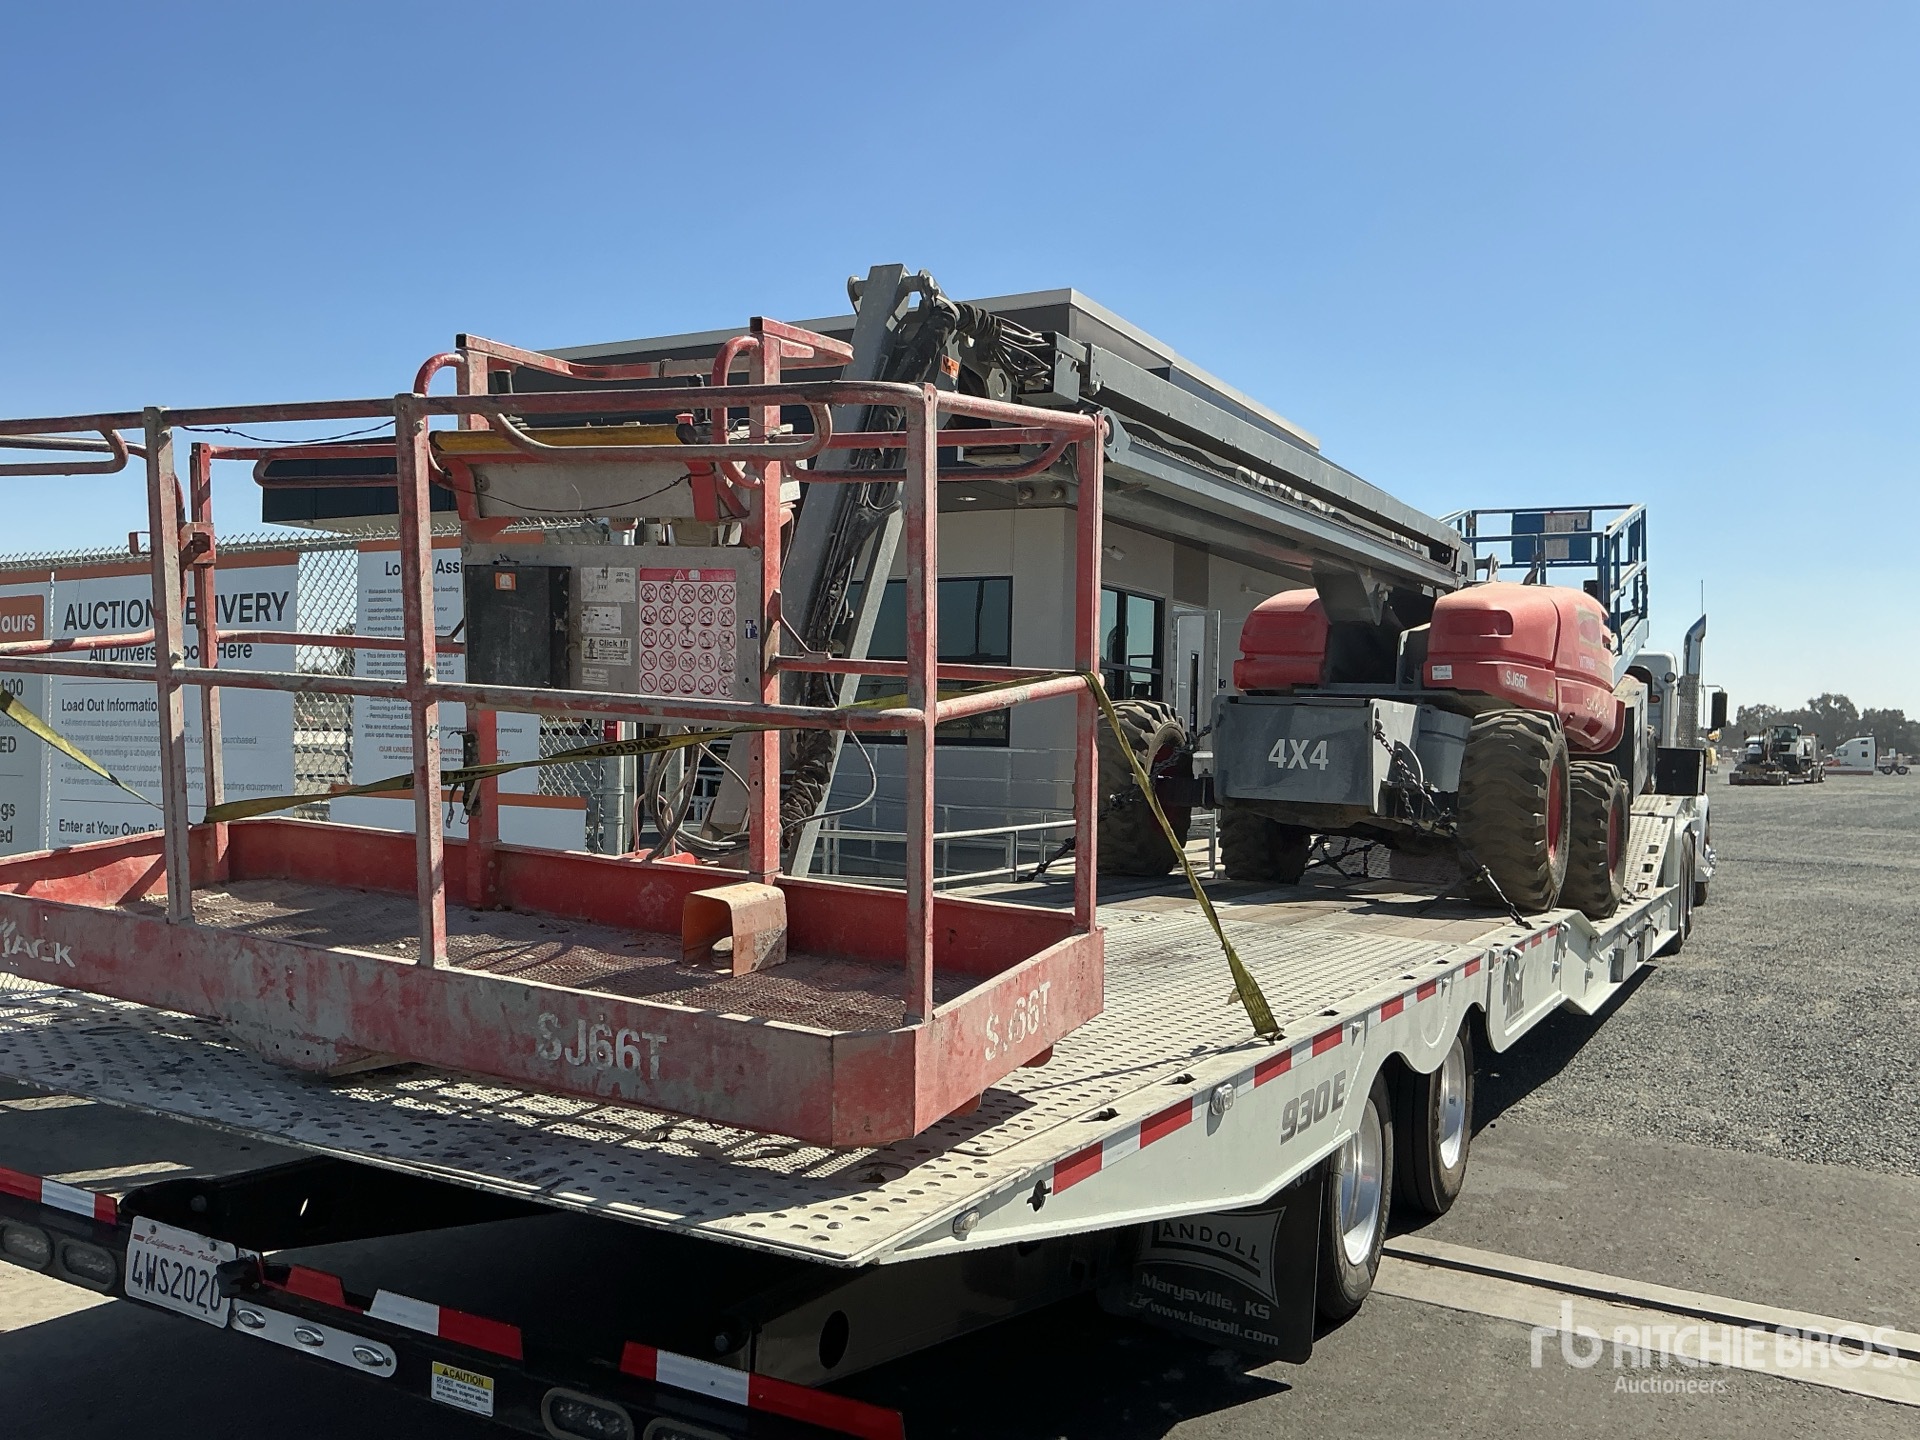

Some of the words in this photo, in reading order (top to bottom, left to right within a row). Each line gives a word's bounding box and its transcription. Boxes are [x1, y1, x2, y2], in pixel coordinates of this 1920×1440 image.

[0, 612, 36, 634] ours
[598, 639, 618, 648] Click
[1505, 670, 1528, 689] SJ66T
[61, 699, 85, 712] Load
[87, 698, 106, 712] Out
[107, 697, 160, 712] Informatio
[1268, 738, 1329, 771] 4X4
[59, 819, 84, 833] Enter
[85, 821, 95, 834] at
[96, 821, 119, 836] Your
[985, 981, 1051, 1061] S66T
[537, 1012, 668, 1080] SJ66T
[1280, 1069, 1347, 1146] 930E
[145, 1235, 176, 1251] California
[1141, 1271, 1238, 1314] Marysville,
[1244, 1300, 1270, 1320] KS
[1150, 1302, 1279, 1346] www.landoll.com
[449, 1368, 485, 1387] CAUTION
